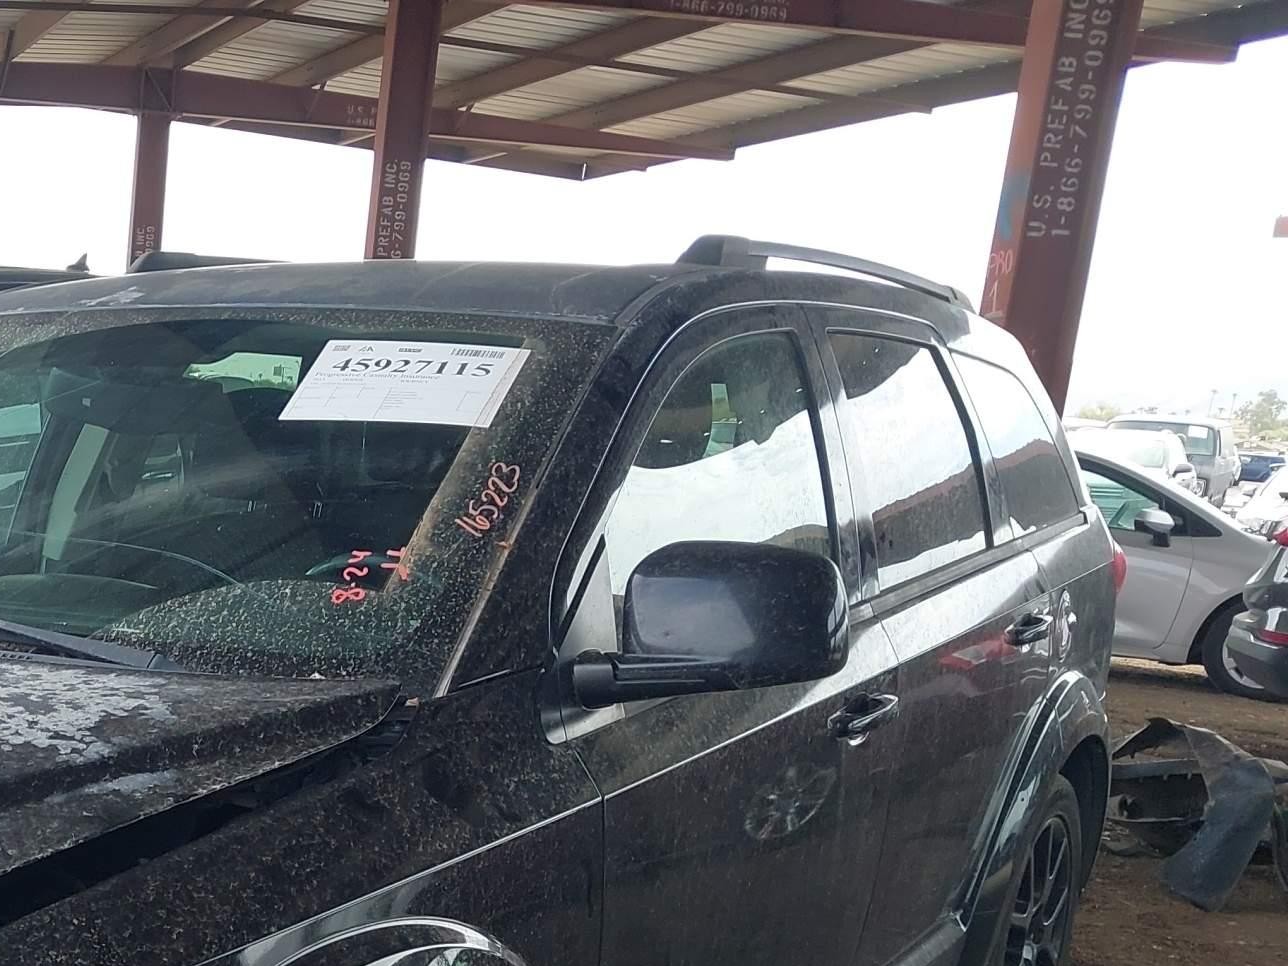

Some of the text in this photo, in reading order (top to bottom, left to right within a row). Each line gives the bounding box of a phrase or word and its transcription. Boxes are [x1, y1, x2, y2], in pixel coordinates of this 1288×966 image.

[1040, 56, 1078, 168] PREFAB
[1051, 0, 1114, 237] 1-866-799-096
[376, 158, 398, 257] PREFAB INC.
[1026, 184, 1056, 238] U.S.
[332, 357, 495, 377] 45927115
[455, 462, 520, 537] 165223
